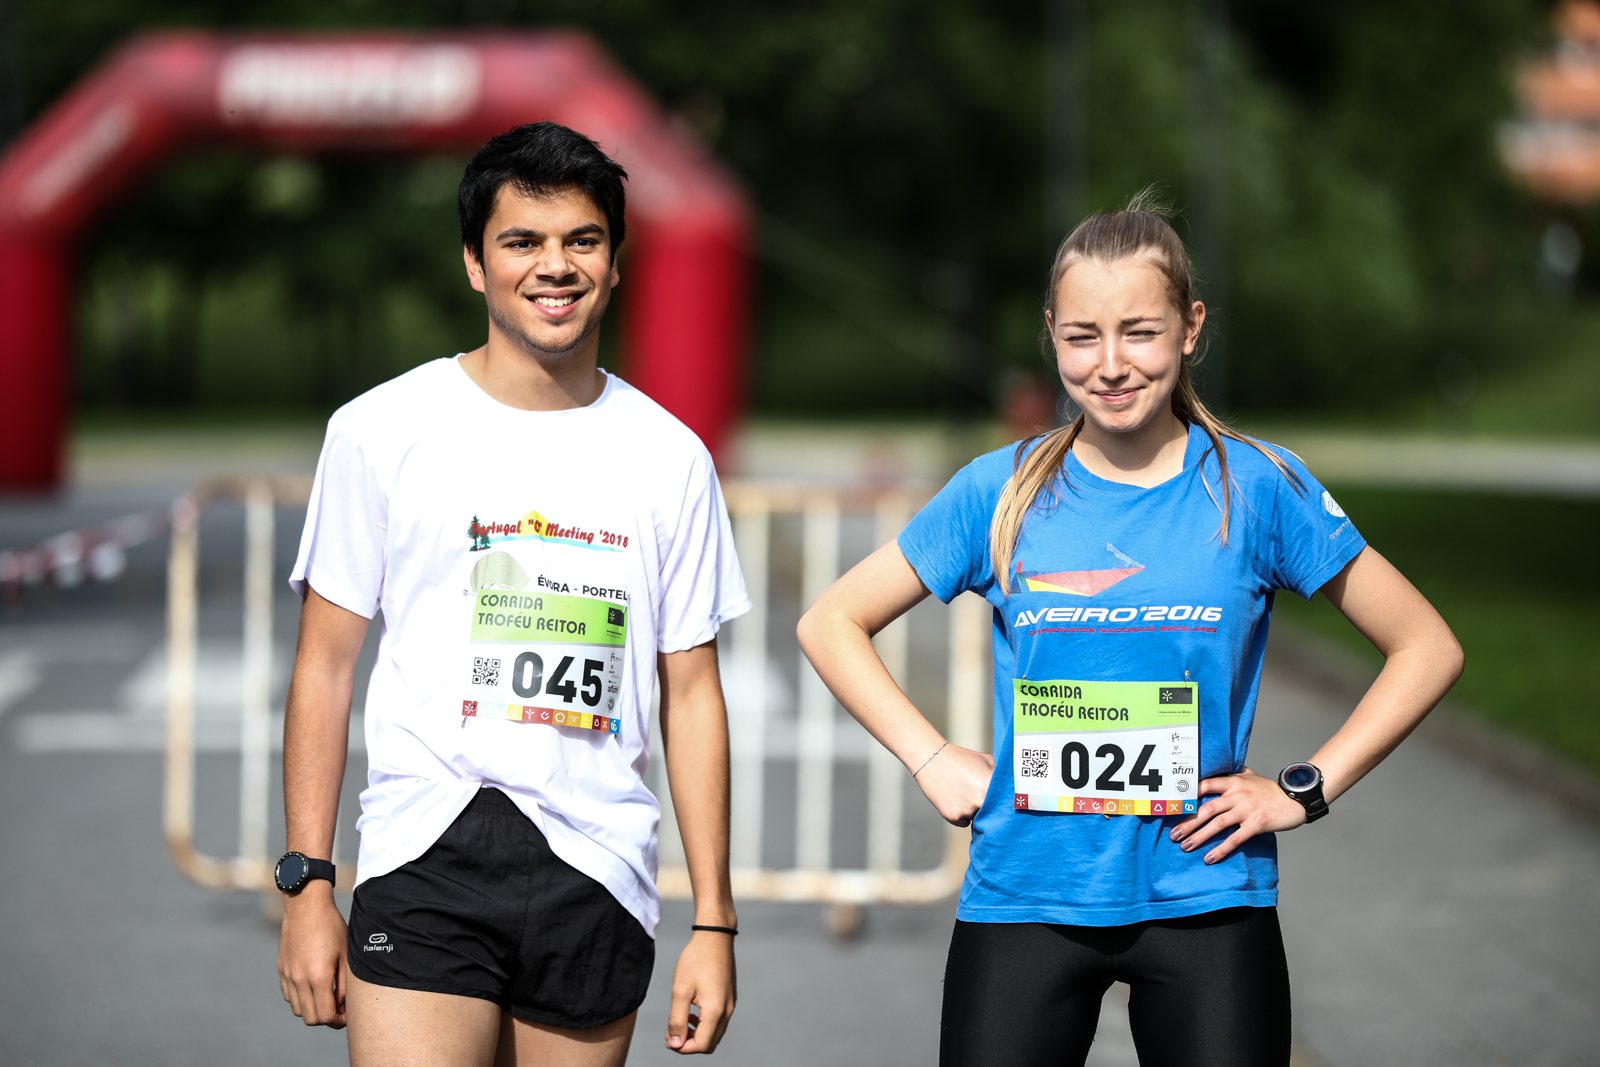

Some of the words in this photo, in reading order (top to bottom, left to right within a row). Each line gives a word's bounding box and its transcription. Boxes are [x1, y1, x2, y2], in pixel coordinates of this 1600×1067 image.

[471, 520, 522, 536] Portugal
[545, 522, 594, 545] Meeting
[599, 529, 629, 548] '2018
[480, 594, 543, 610] CORRIDA
[478, 612, 532, 629] TROFÉU
[536, 617, 586, 636] REITOR
[1158, 625, 1217, 633] ESCOLARES
[512, 651, 605, 707] 045
[1021, 684, 1082, 700] CORRIDA
[1021, 701, 1074, 719] TROFÉU
[1078, 706, 1129, 721] REITOR
[1061, 741, 1163, 792] 024
[363, 944, 394, 953] Kalenji
